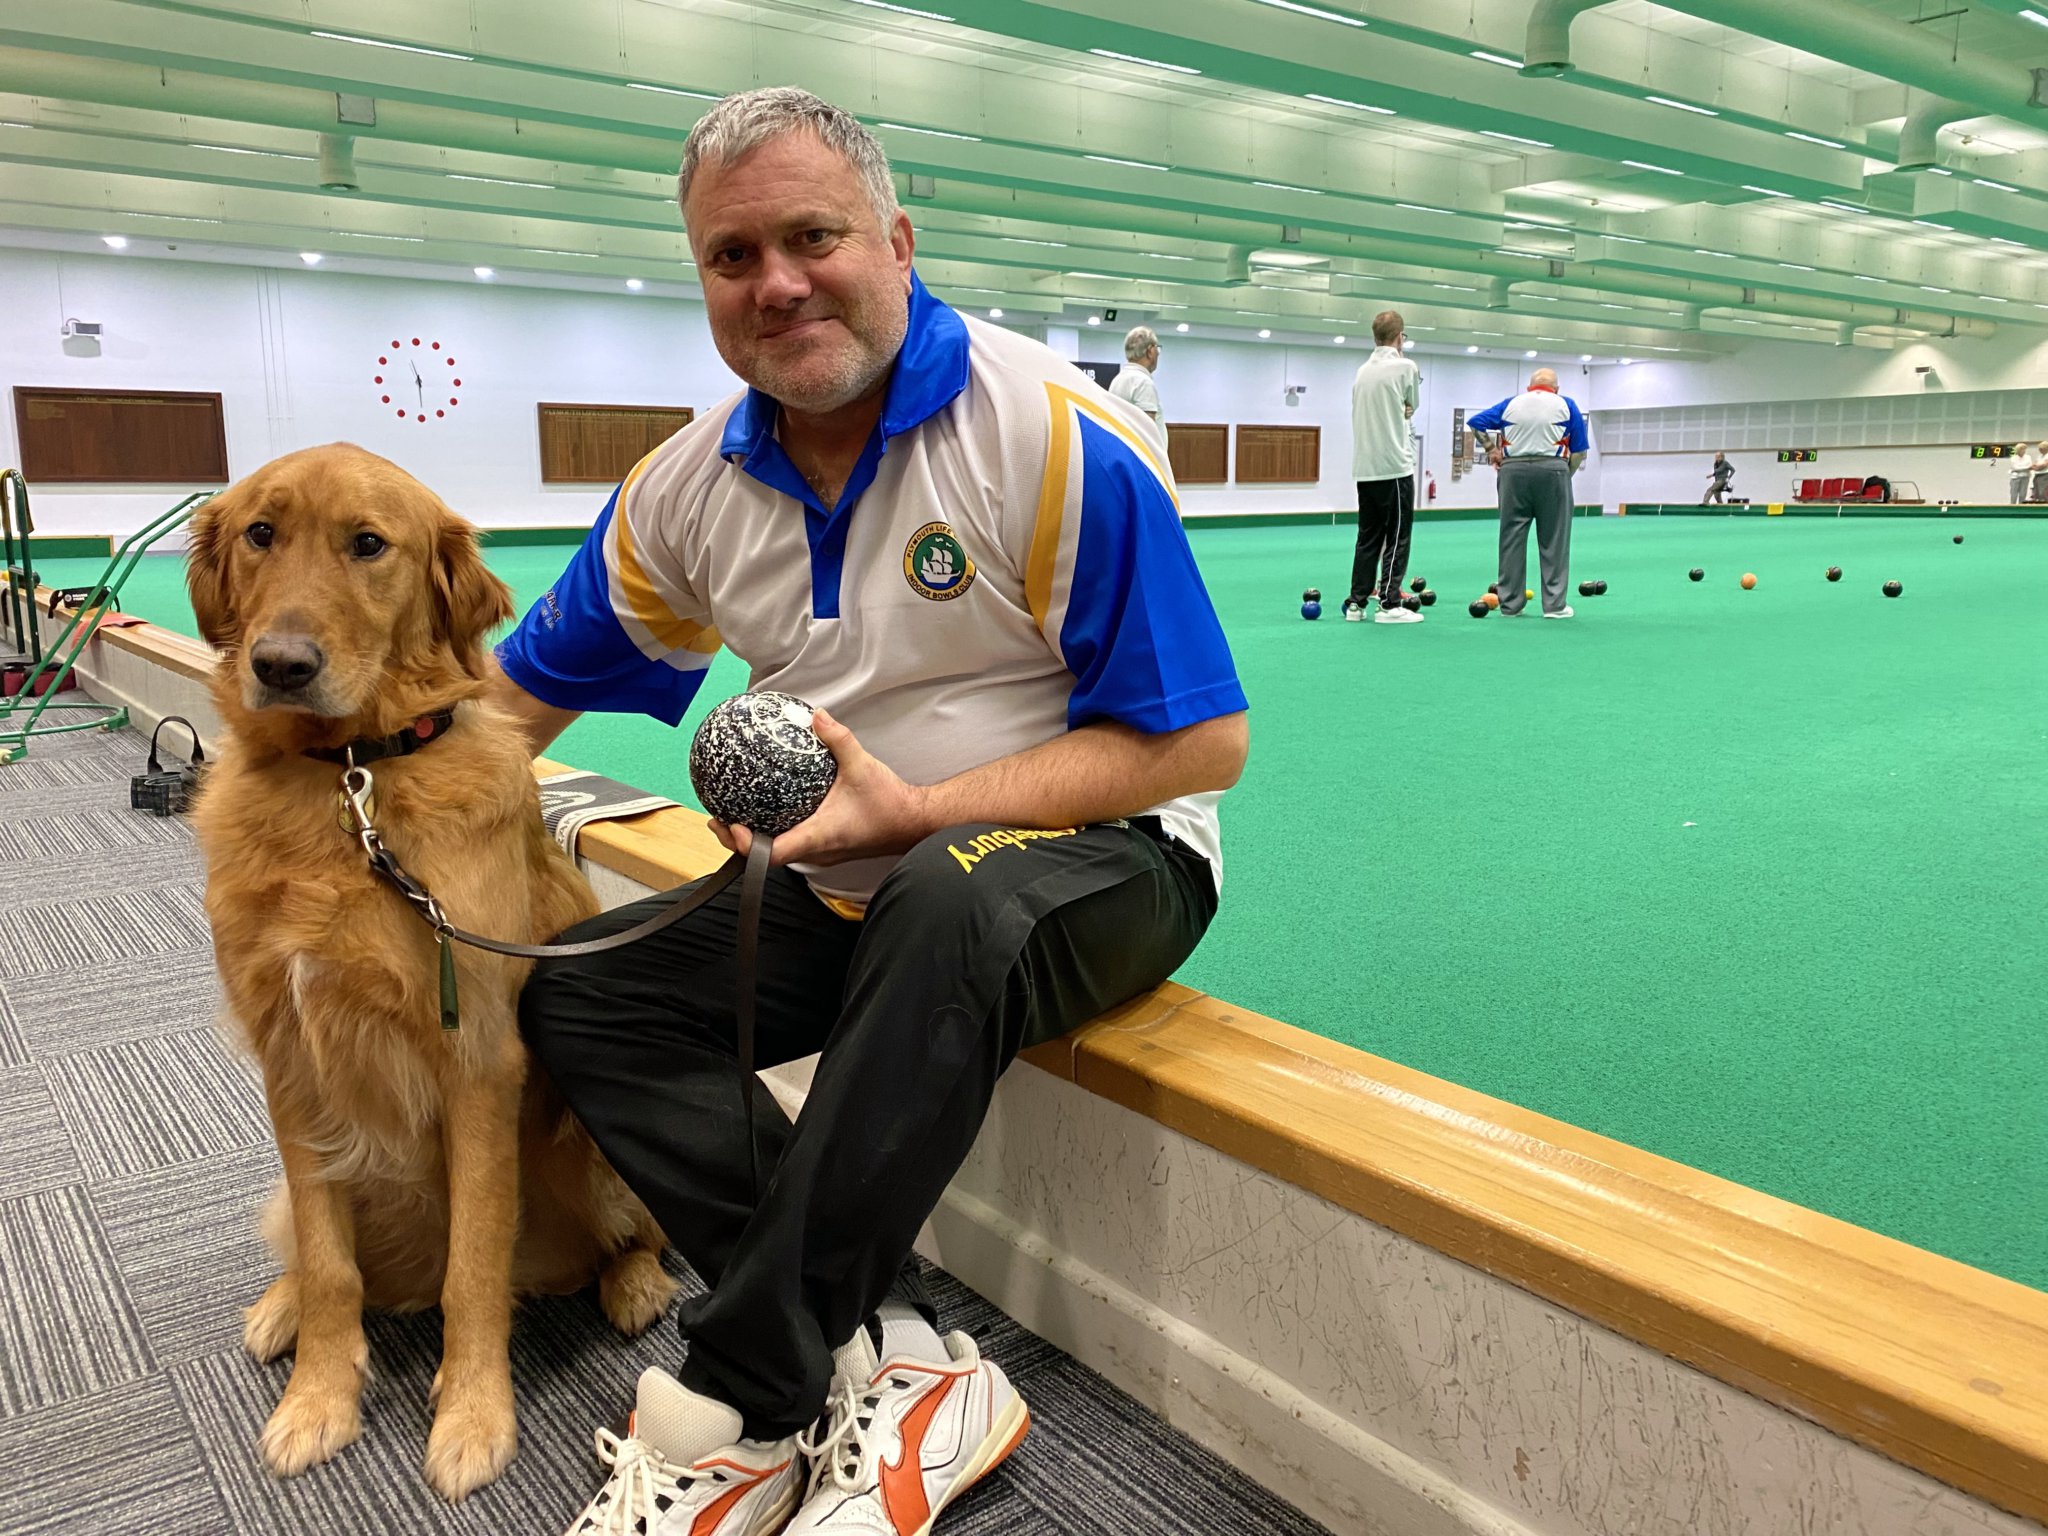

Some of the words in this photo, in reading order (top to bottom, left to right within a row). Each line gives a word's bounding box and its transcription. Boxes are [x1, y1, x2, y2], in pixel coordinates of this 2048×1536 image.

[1782, 452, 1789, 461] 0
[1796, 451, 1803, 461] 2
[1810, 451, 1817, 461] 0
[1976, 447, 1985, 457] 8
[1993, 447, 2001, 457] 9
[1990, 458, 1997, 467] 2
[907, 527, 934, 558] PLYMOUTH
[935, 525, 952, 535] LIFE
[907, 573, 931, 598] INDOOR
[932, 589, 959, 600] BOWLS
[958, 574, 974, 592] CLUB
